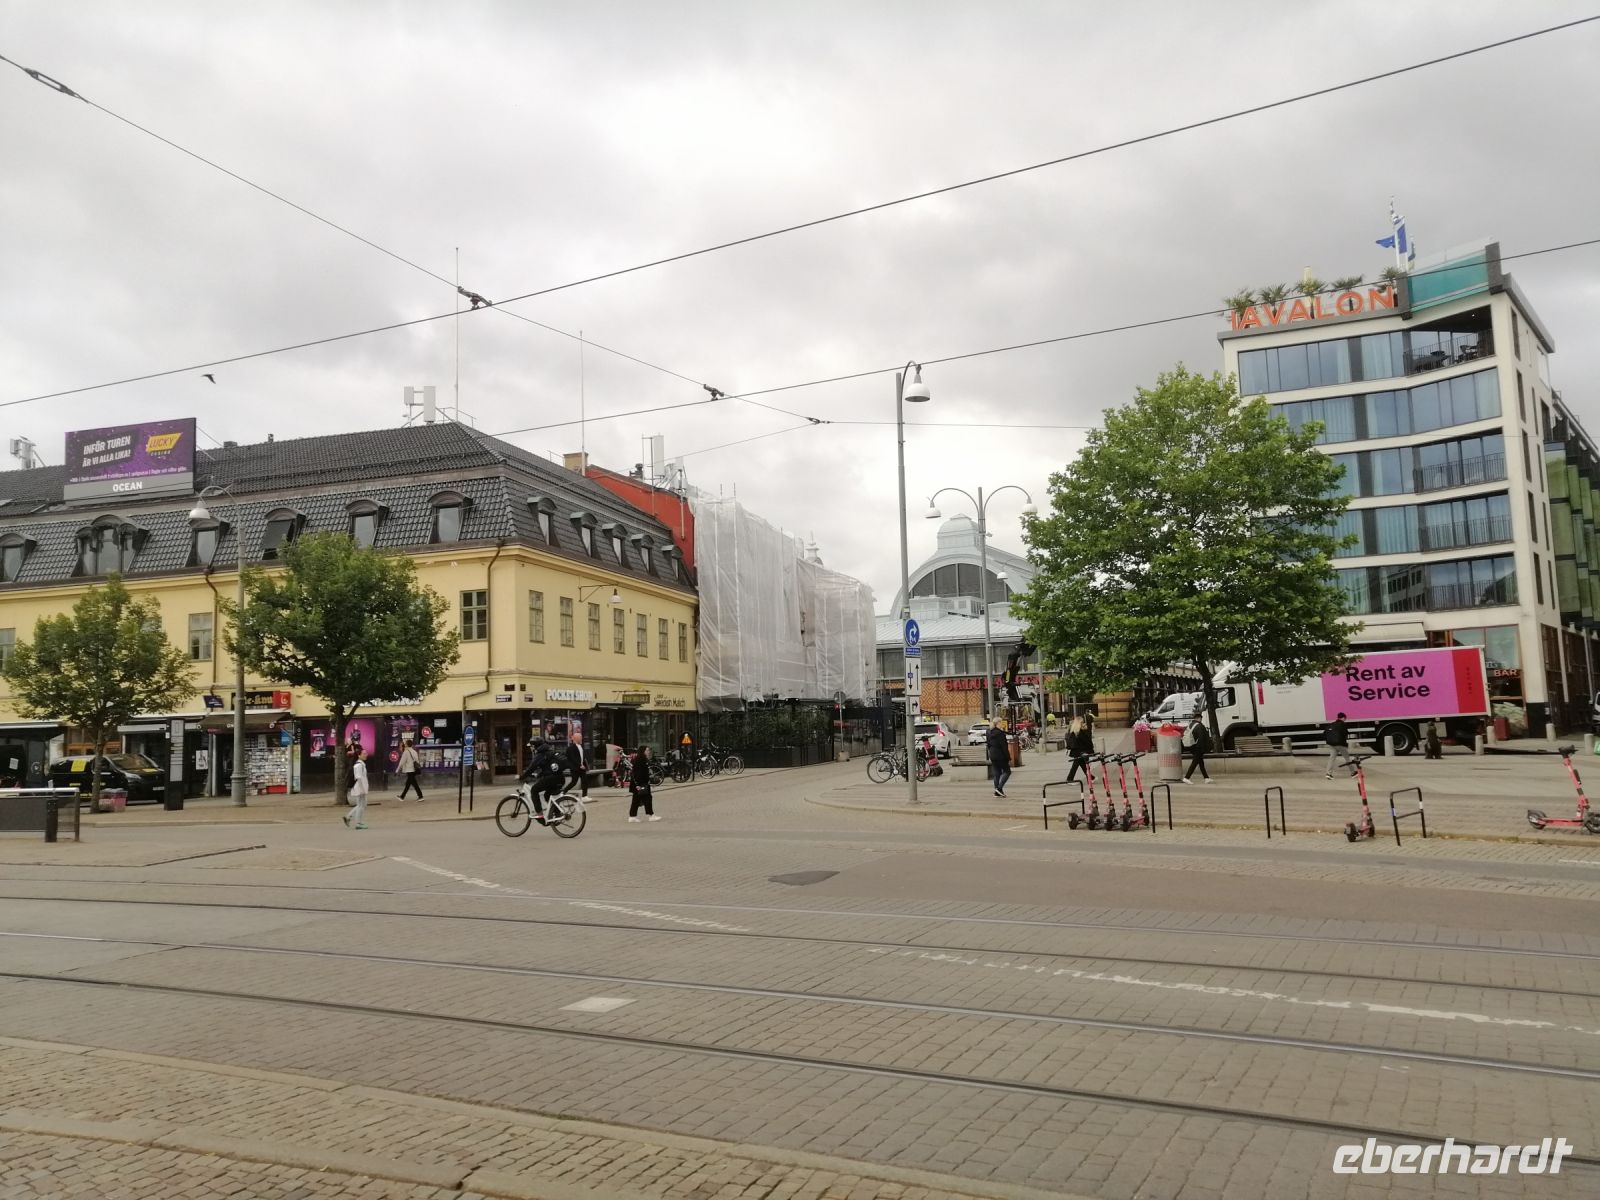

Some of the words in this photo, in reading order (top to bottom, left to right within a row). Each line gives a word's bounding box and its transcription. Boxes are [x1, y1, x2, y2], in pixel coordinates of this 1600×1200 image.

[1232, 285, 1394, 330] AVALON
[83, 440, 106, 455] INFÖR
[107, 435, 131, 450] TUREN
[112, 481, 143, 492] OCEAN
[1346, 665, 1396, 682] Rent
[1401, 666, 1425, 679] av
[1493, 668, 1518, 678] BAR
[1348, 683, 1430, 701] Service
